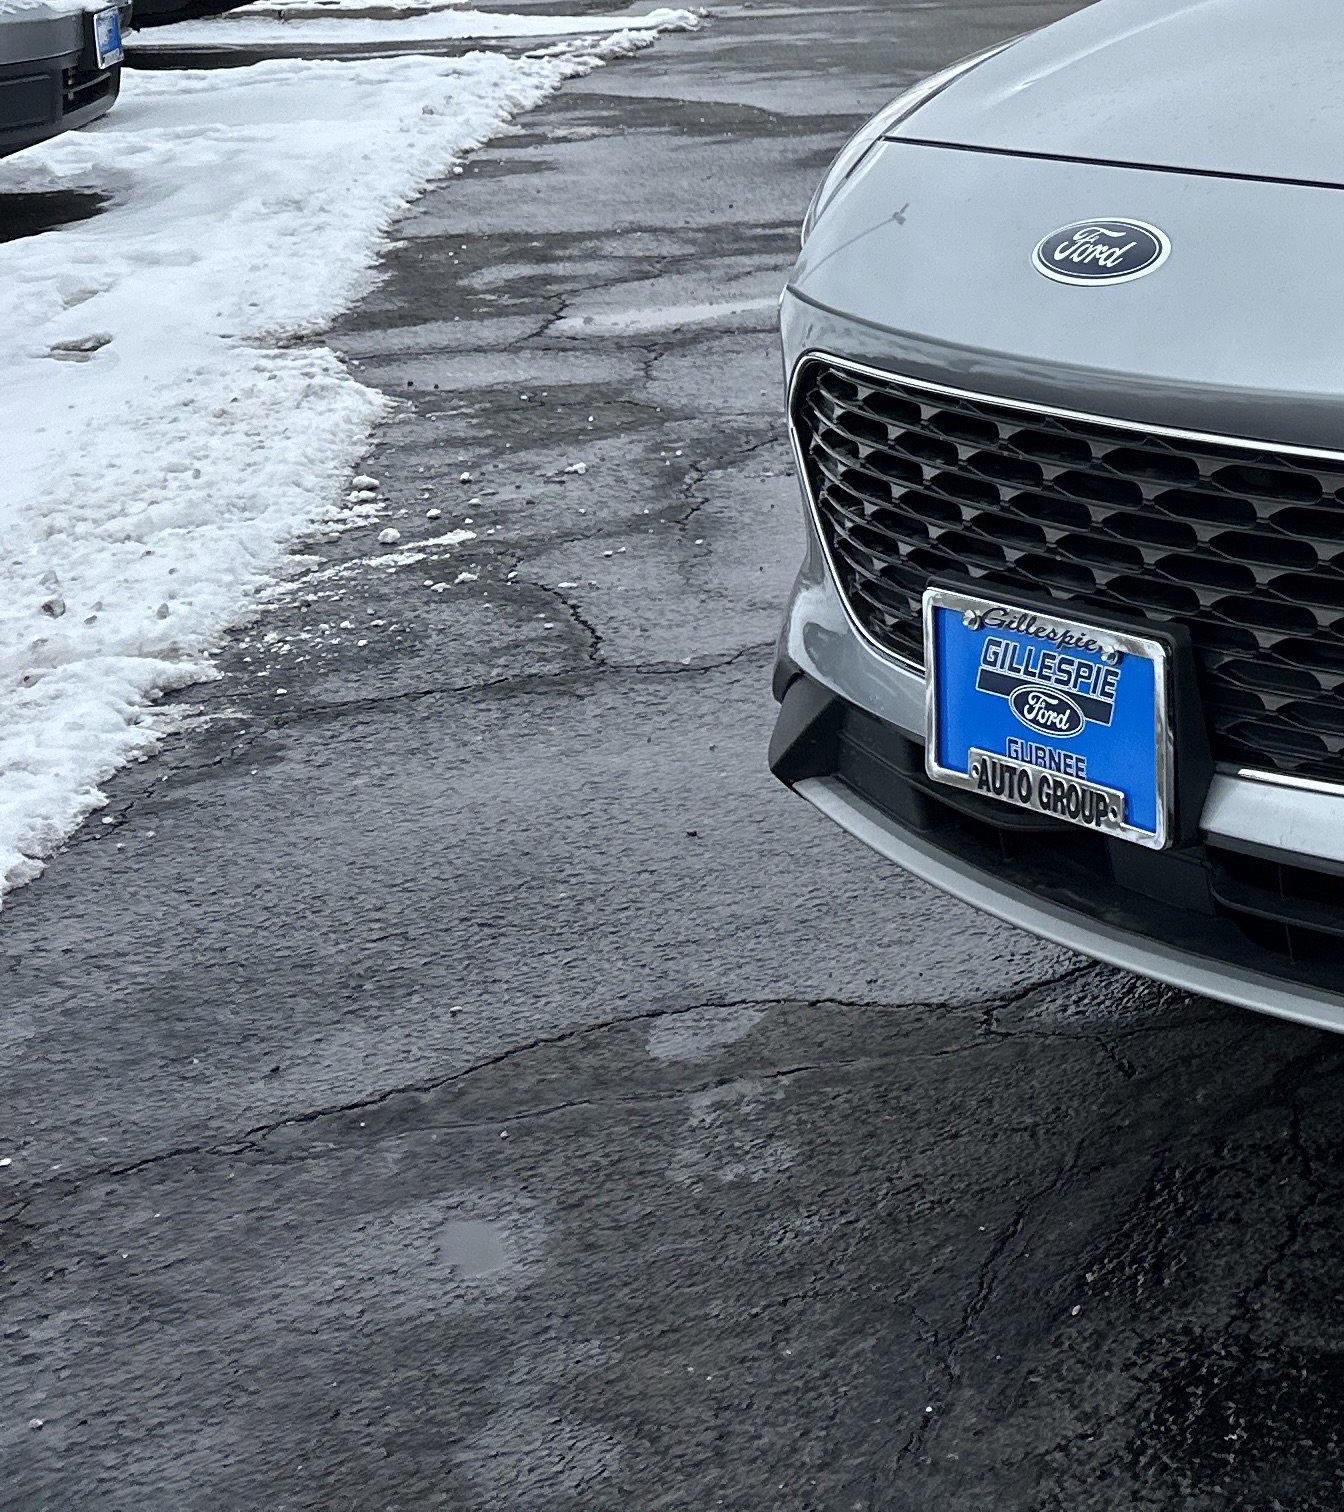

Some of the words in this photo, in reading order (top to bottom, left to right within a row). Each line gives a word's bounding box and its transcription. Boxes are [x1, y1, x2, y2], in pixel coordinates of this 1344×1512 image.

[1053, 226, 1138, 268] Ford
[981, 607, 1100, 652] Gillespie
[980, 636, 1121, 700] GILLESPIE
[1023, 692, 1070, 731] Ford
[1006, 737, 1087, 780] GURNEE
[977, 756, 1033, 804] AUTO
[1037, 773, 1110, 827] GROUP
